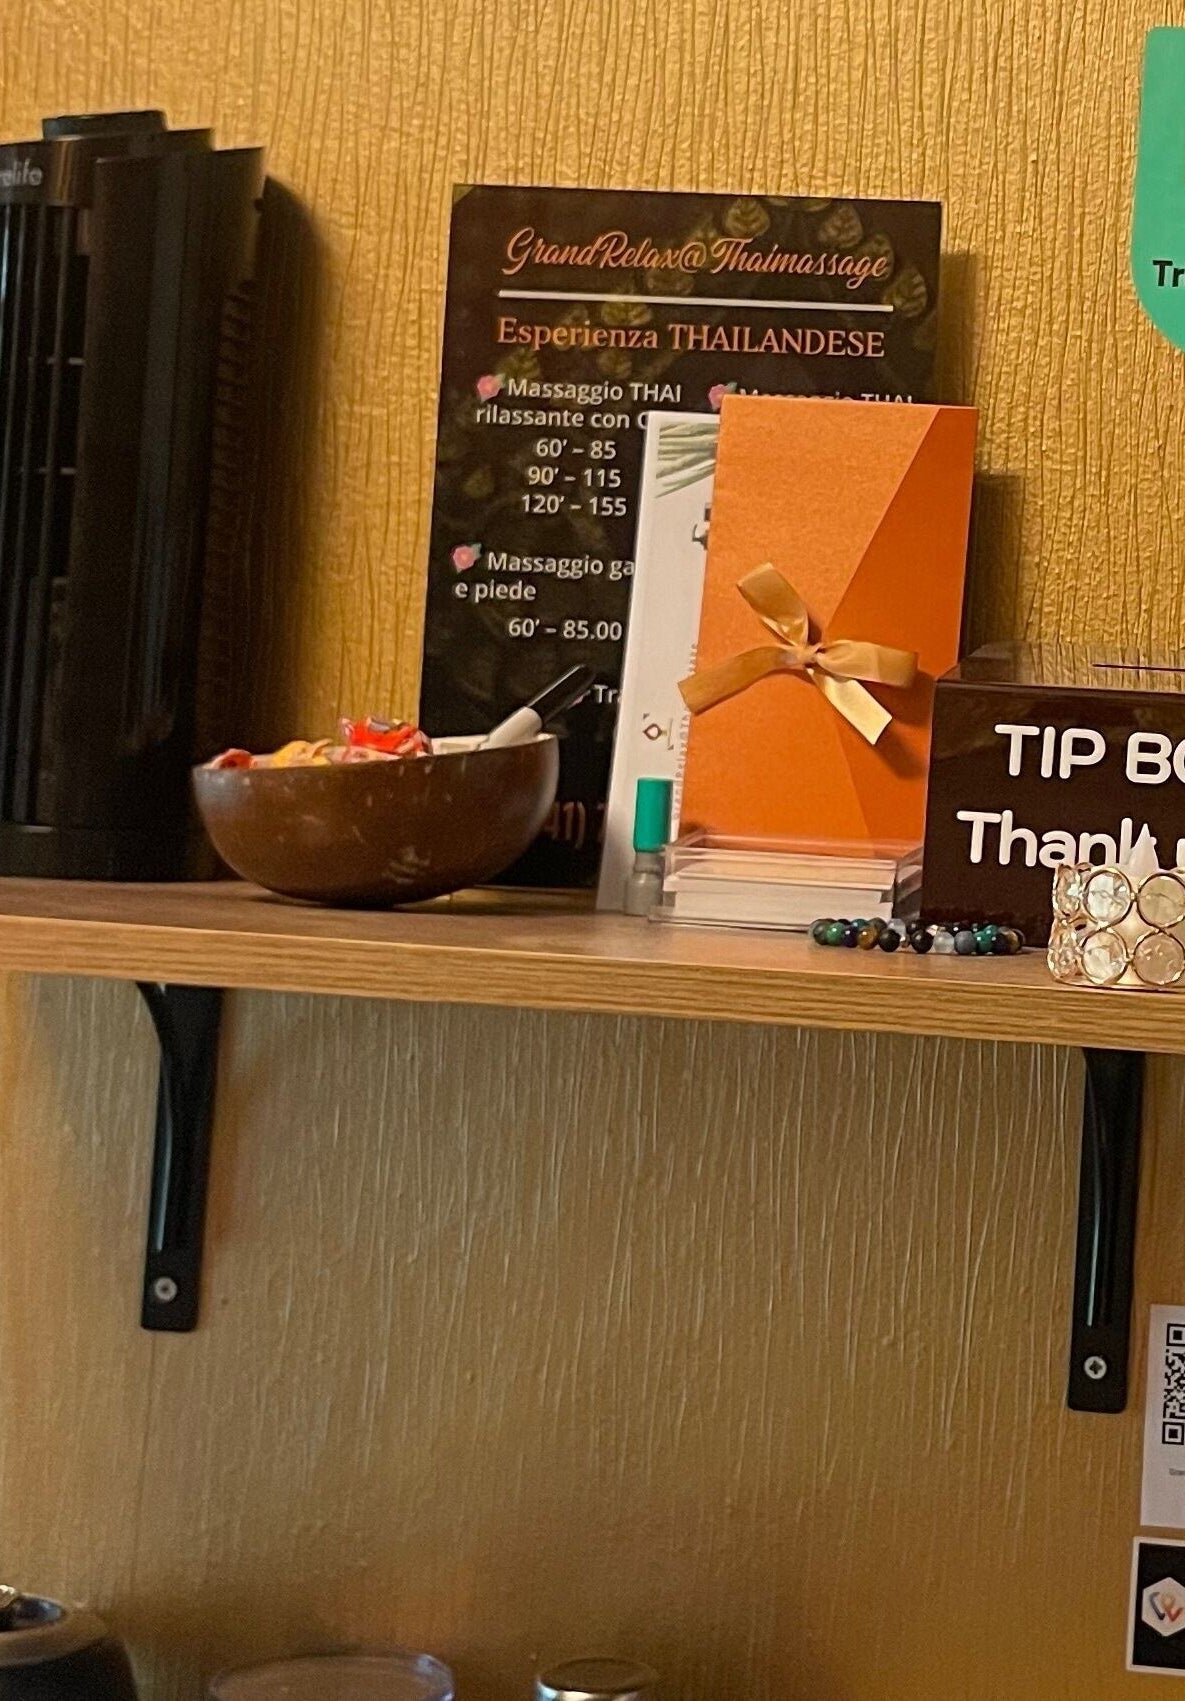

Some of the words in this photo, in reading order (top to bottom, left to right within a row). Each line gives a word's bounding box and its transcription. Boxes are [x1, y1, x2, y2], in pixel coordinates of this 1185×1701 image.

[496, 316, 659, 351] Esperienza
[667, 323, 885, 358] THAILANDESE
[507, 377, 623, 405] Massaggio
[629, 381, 682, 403] THAI
[475, 403, 585, 428] rilassante
[590, 412, 631, 429] con
[535, 437, 568, 459] 60'
[589, 438, 617, 460] 85
[527, 465, 559, 486] 90'
[583, 467, 622, 488] 115
[521, 493, 565, 514] 120'
[588, 495, 628, 517] 155
[487, 551, 604, 579] Massaggio
[454, 581, 469, 599] e
[474, 578, 537, 603] piede
[507, 617, 541, 638] 60'
[562, 618, 623, 640] 85.00
[592, 683, 621, 704] Tr
[994, 723, 1106, 780] TIP
